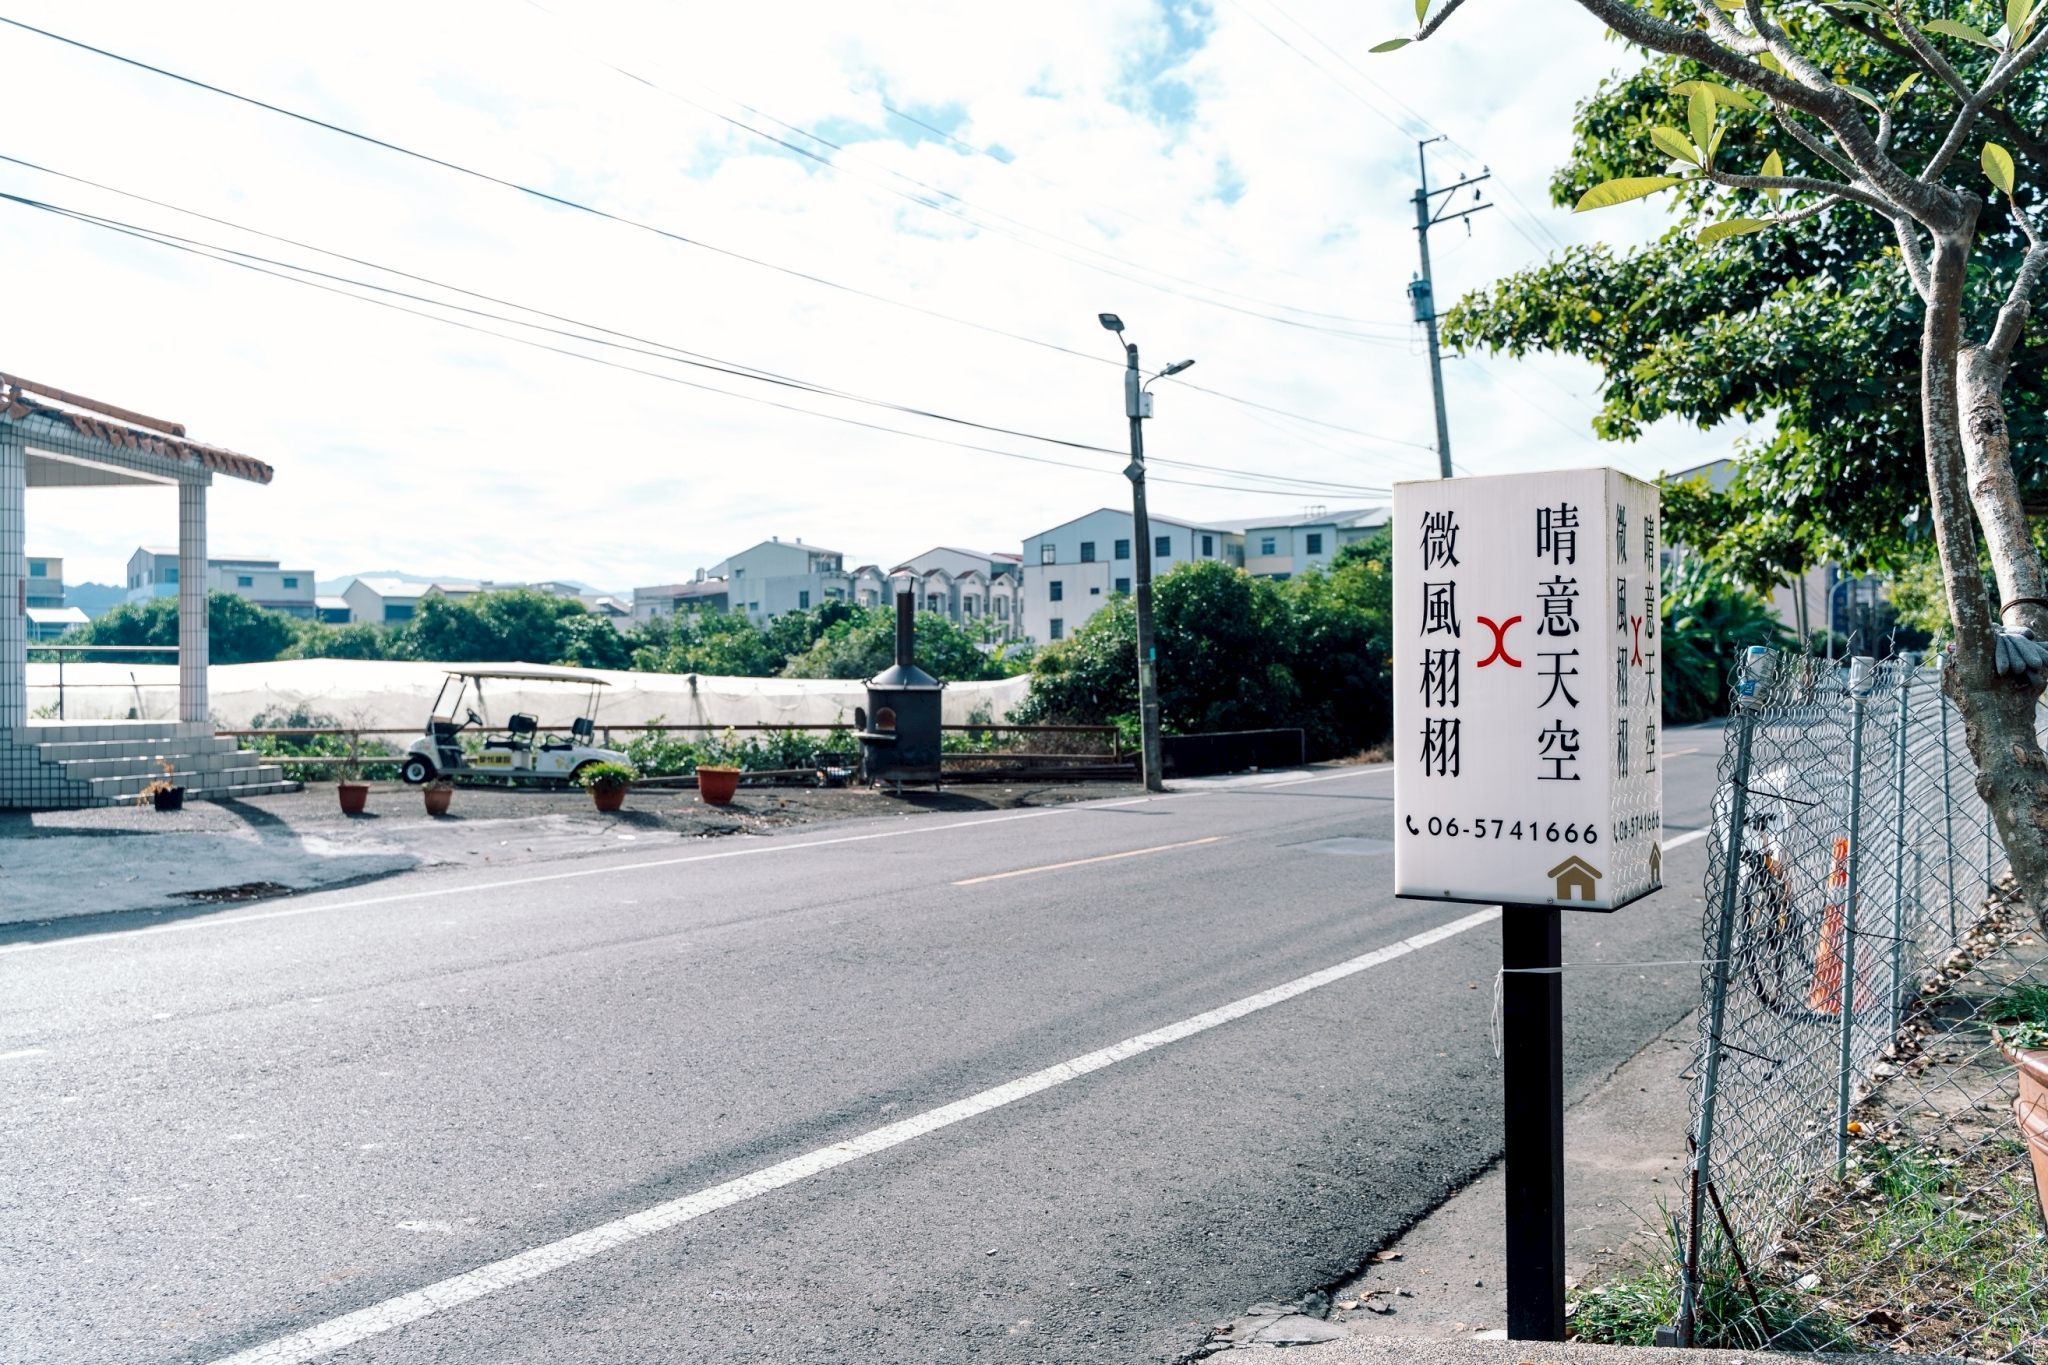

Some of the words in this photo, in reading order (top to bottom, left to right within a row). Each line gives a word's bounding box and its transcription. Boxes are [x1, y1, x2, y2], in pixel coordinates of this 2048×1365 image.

[1419, 510, 1461, 778] 微風栩栩
[1536, 502, 1581, 781] 晴意天空
[1616, 503, 1629, 780] 微風栩栩
[1643, 514, 1656, 774] 晴意天空
[1427, 816, 1598, 845] 06-5741666
[1619, 809, 1660, 841] 06-5741666
